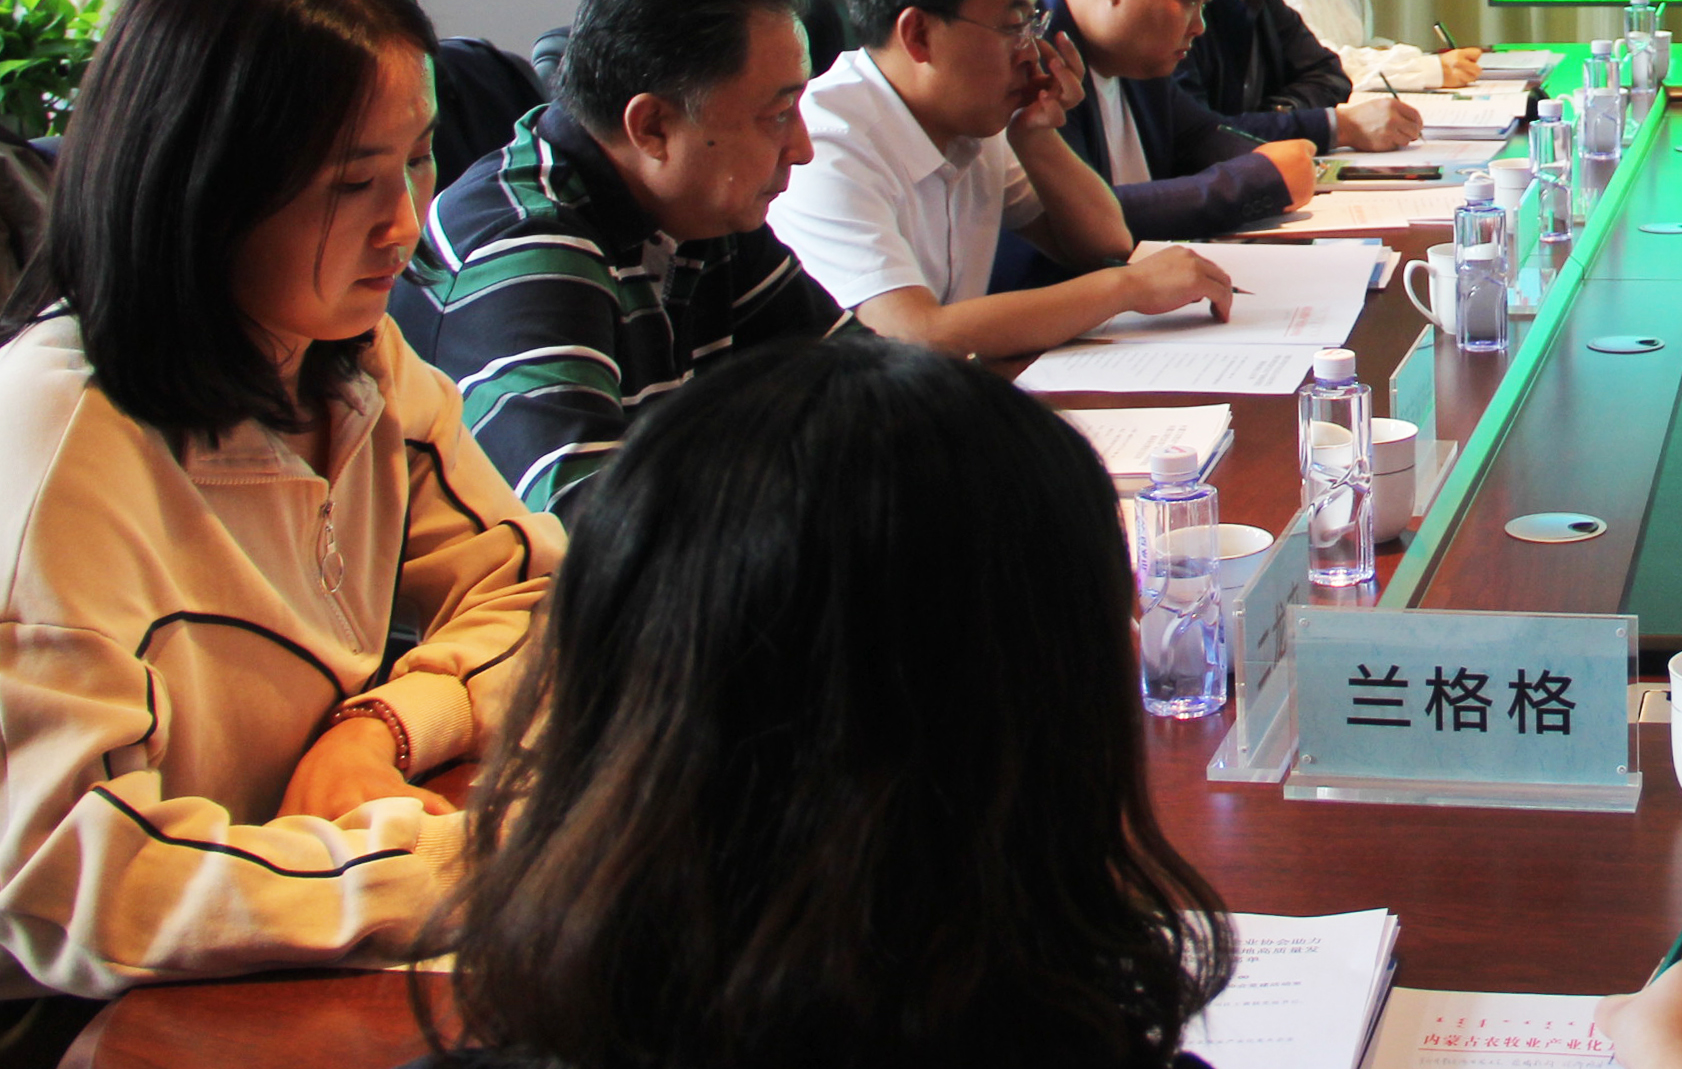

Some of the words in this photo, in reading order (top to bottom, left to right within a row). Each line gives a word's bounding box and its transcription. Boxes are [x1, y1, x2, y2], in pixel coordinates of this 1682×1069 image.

[1347, 663, 1576, 735] 兰格格
[1423, 1034, 1615, 1051] 内蒙古农牧业产业化
